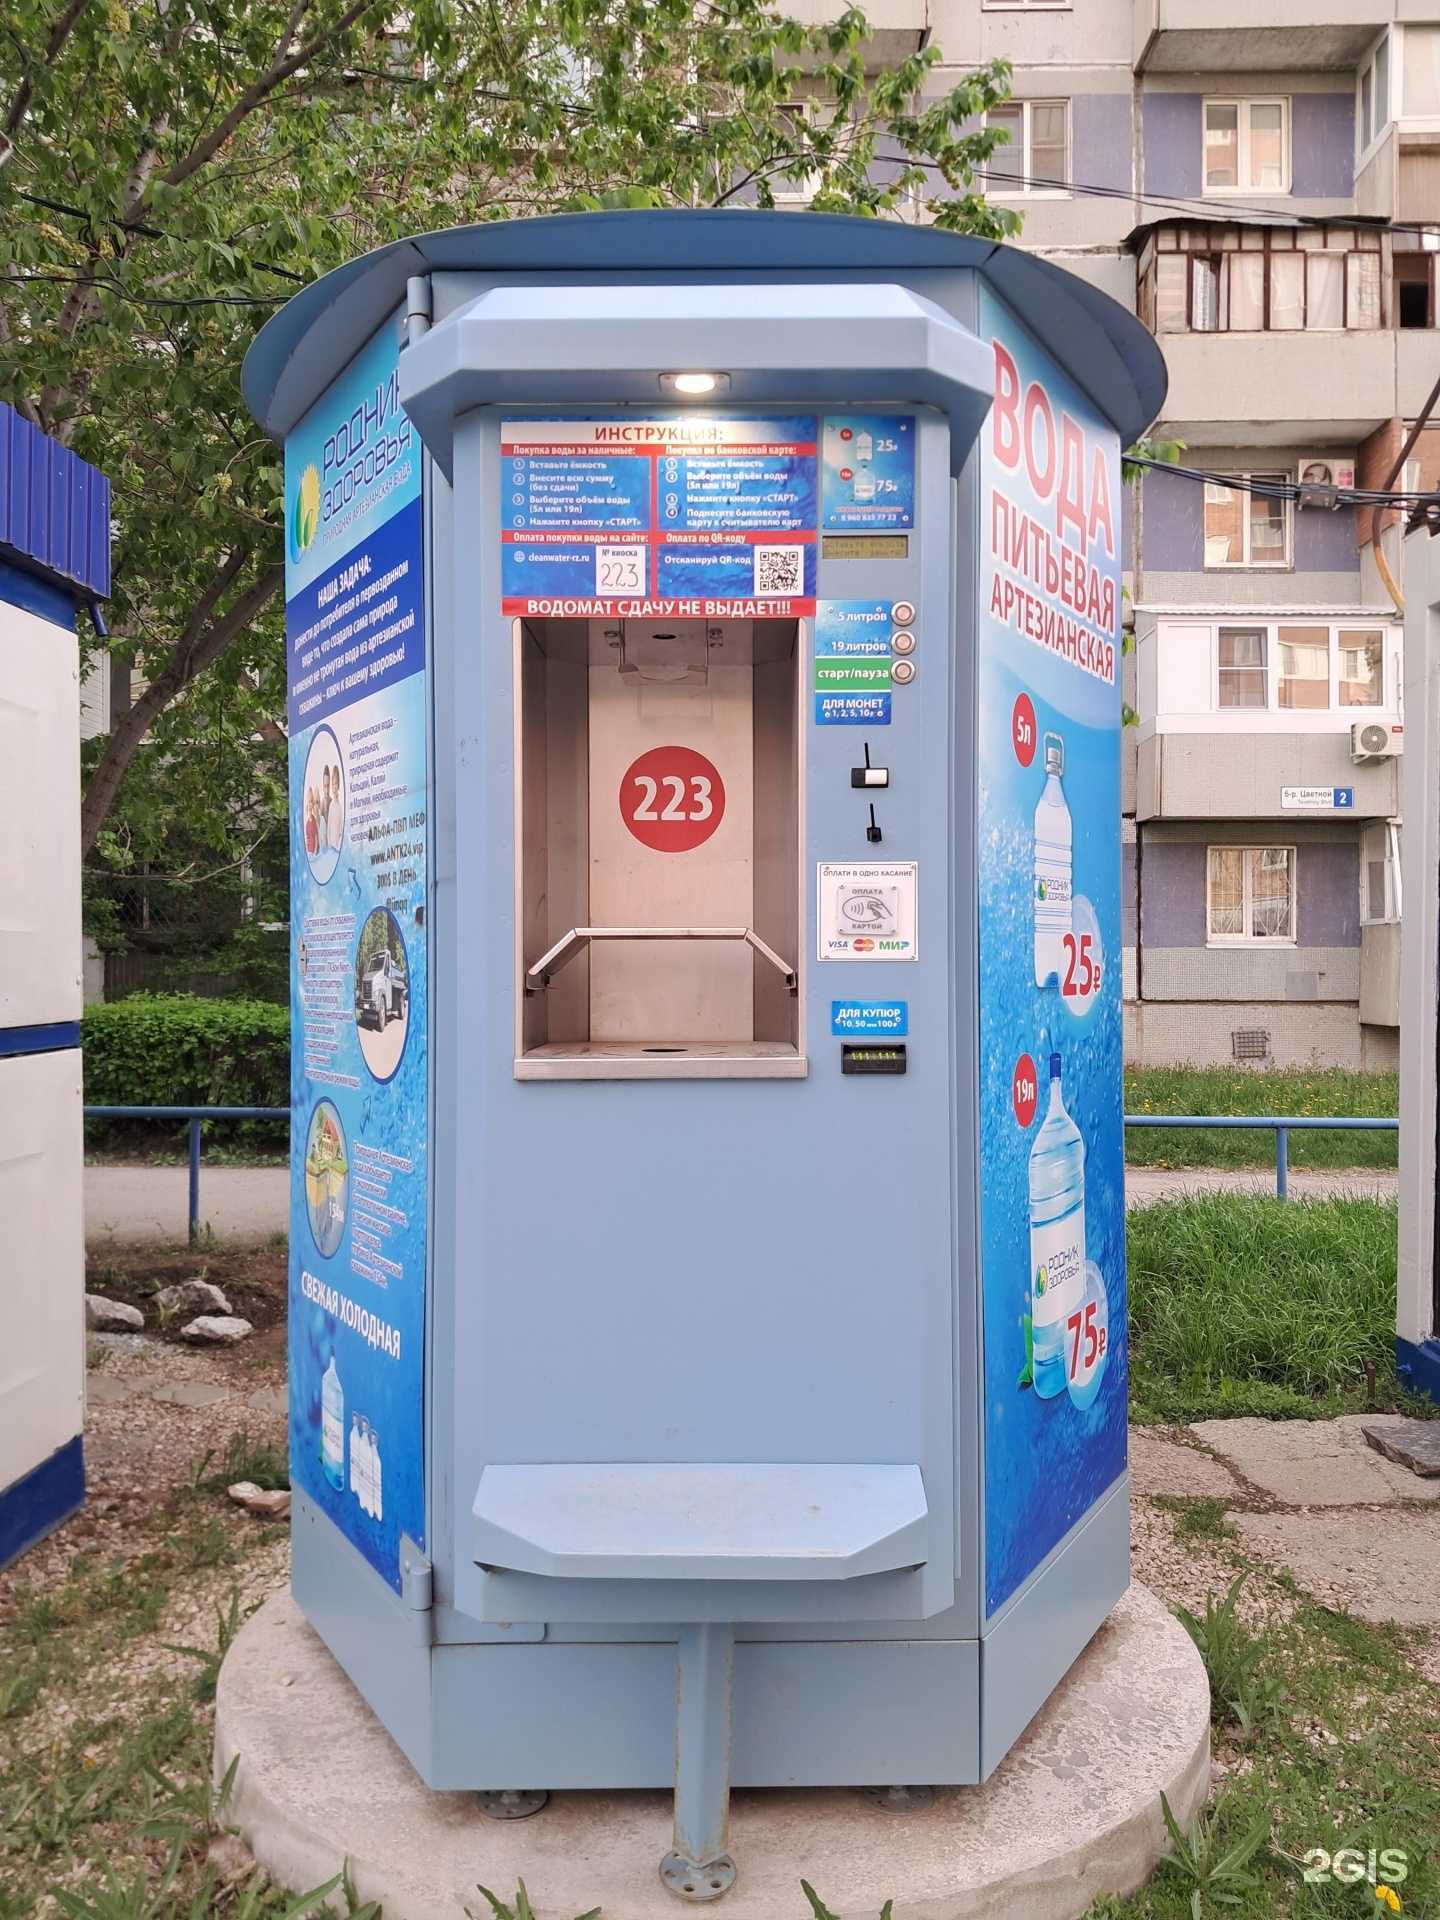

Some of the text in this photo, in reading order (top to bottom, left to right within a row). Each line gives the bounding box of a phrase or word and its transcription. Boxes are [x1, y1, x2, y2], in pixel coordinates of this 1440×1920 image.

[595, 427, 723, 441] ИНСТРУКЦИЯ:
[513, 445, 550, 455] Покупка
[552, 446, 575, 455] воды
[588, 446, 636, 454] наличные:
[768, 447, 797, 456] карте:
[992, 340, 1114, 555] ВОДА
[323, 416, 411, 522] ЗДОРОВЬЯ
[763, 473, 788, 481] воды
[529, 483, 580, 491] (без сдачи)
[529, 496, 574, 505] Выберите
[606, 497, 631, 505] воды
[736, 508, 790, 517] банковскую
[529, 518, 570, 526] Нажмите
[572, 519, 603, 527] кнопку
[606, 518, 641, 526] «СТАРТ»
[513, 532, 545, 542] Оплата
[546, 533, 582, 544] покупки
[583, 534, 609, 543] воды
[622, 532, 649, 542] сайте:
[666, 532, 698, 543] Оплата
[711, 532, 746, 544] QR-коду
[611, 549, 638, 557] киоска
[664, 555, 751, 565] Отсканируй QR-код
[992, 488, 1114, 634] ПИТЬЕВАЯ
[317, 554, 372, 609] НАША ЗАДАЧА:
[360, 559, 409, 604] первозданном
[601, 562, 640, 588] 223
[368, 595, 398, 627] природа
[527, 600, 791, 618] ВОДОМАТ СДАЧУ НЕ ВЫДАЕТ!!!
[839, 612, 887, 623] 5 литров
[367, 607, 415, 652] артезианской
[991, 573, 1114, 682] АРТЕЗИАНСКАЯ
[831, 641, 887, 653] 19 литров
[345, 666, 369, 690] вашему
[368, 642, 405, 677] здоровью!
[817, 668, 889, 680] старт/пауза
[822, 698, 884, 710] ДЛЯ МОНЕТ
[1017, 715, 1031, 746] 5л
[632, 775, 713, 821] 223
[1340, 792, 1347, 804] 2
[368, 815, 408, 843] АЛЬФА-ПВП
[408, 809, 425, 829] МЕФ
[398, 867, 416, 885] ДЕНЬ
[879, 941, 910, 950] МИР
[839, 1008, 901, 1019] ДЛЯ КУПЮР
[1016, 1078, 1034, 1105] 19л
[1048, 1245, 1080, 1271] РОДНИК
[1048, 1261, 1080, 1291] ЗДОРОВЬЯ
[301, 1270, 338, 1318] СВЕЖАЯ
[339, 1294, 401, 1360] ХОЛОДНАЯ
